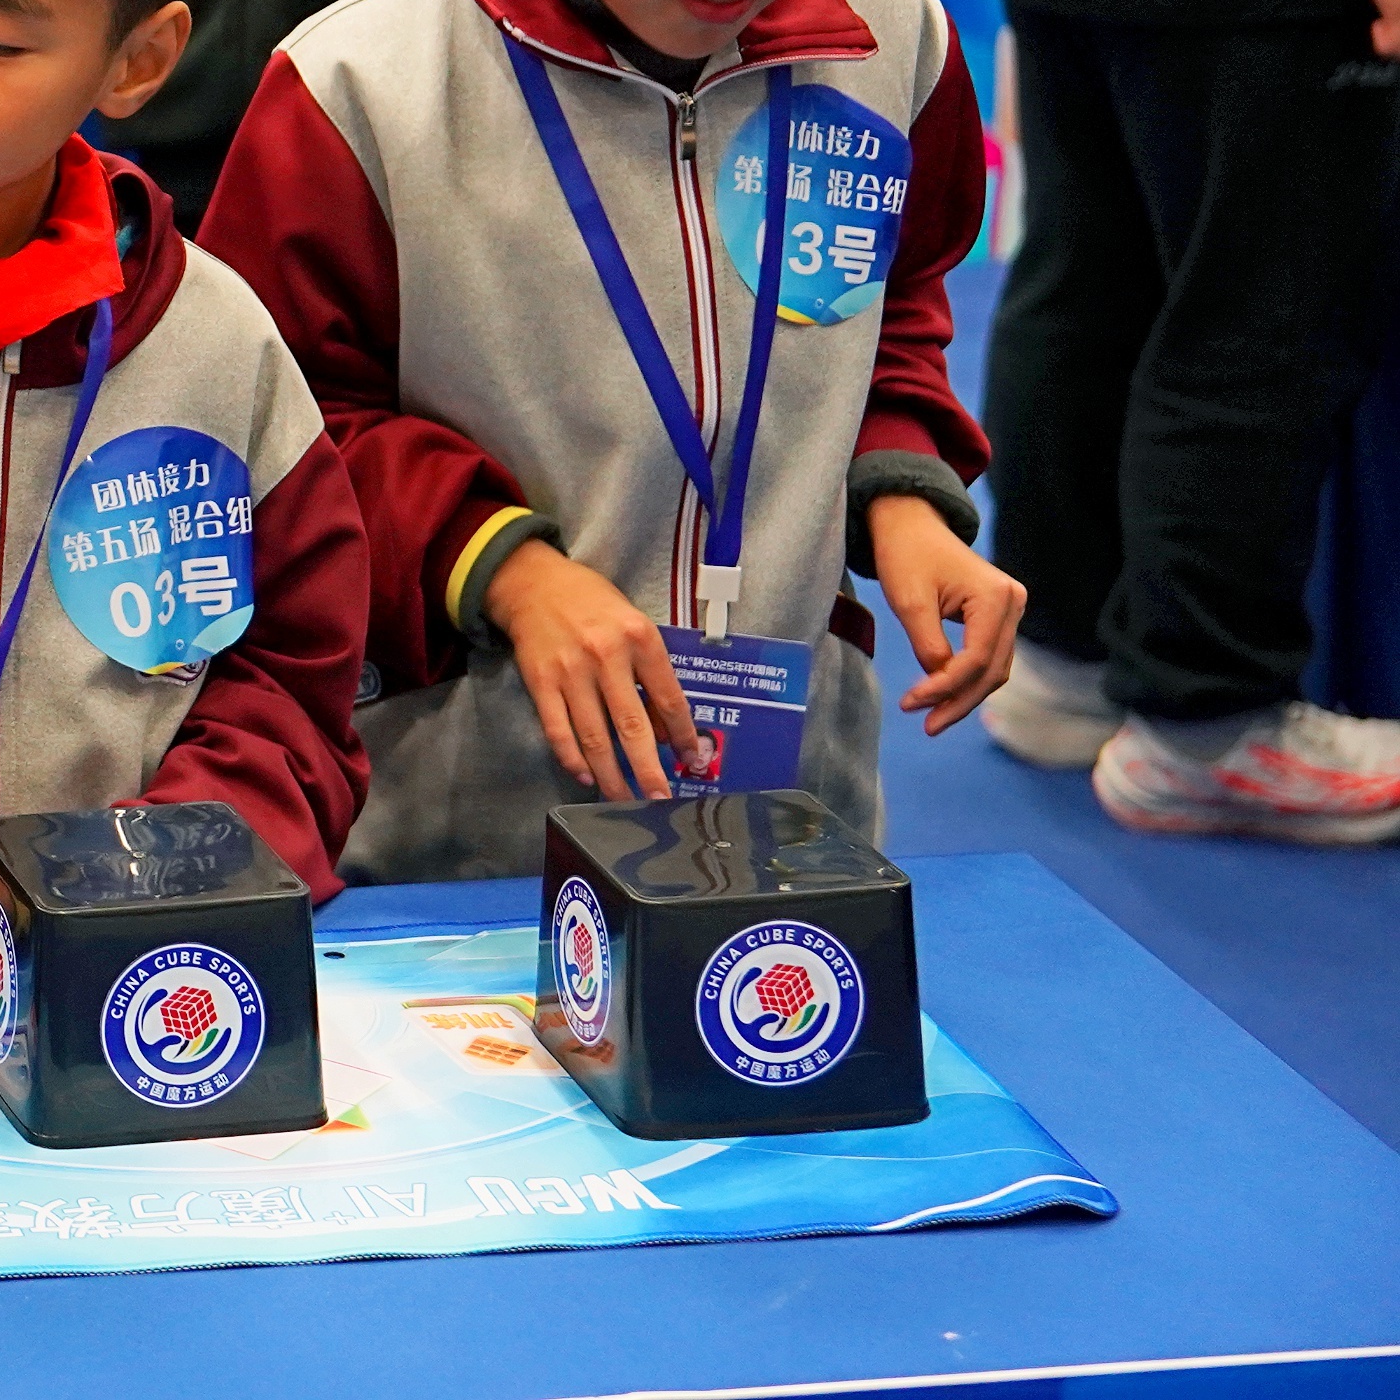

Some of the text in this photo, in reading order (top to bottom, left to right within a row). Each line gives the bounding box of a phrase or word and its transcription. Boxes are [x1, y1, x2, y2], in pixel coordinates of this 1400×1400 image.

[788, 120, 880, 161] 体接力
[733, 154, 908, 215] 第场 混合组
[756, 218, 876, 284] 3号
[91, 458, 211, 513] 团体接力
[62, 496, 253, 573] 第五场 混合组
[109, 555, 238, 638] 03号
[694, 704, 740, 726] 赛证
[556, 884, 609, 980] CHINA CUBE SPORTS
[111, 952, 257, 1020] CHINA CUBE SPORTS
[705, 929, 854, 1000] CHINA CUBE SPORTS
[419, 1010, 516, 1030] 训练
[135, 1073, 230, 1102] 中国魔方运动
[734, 1049, 831, 1080] 中国魔方运动
[464, 1167, 682, 1218] WCU
